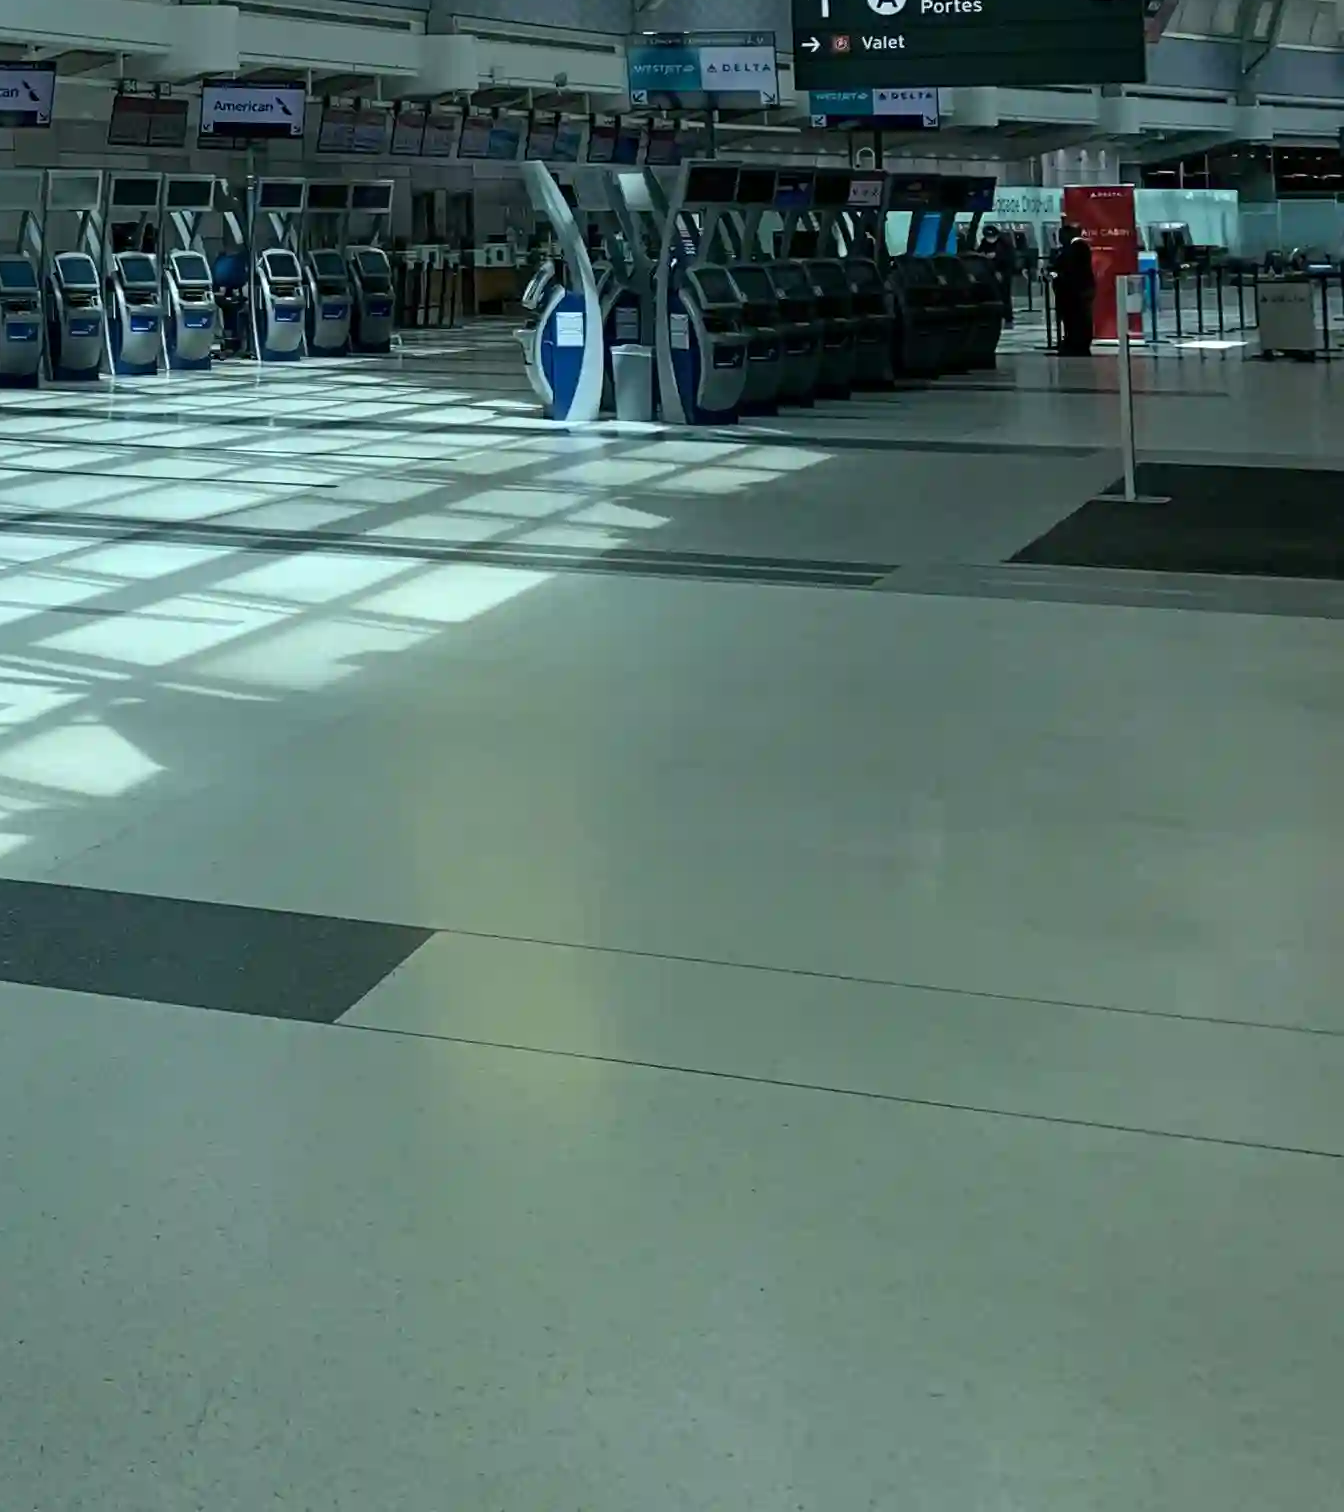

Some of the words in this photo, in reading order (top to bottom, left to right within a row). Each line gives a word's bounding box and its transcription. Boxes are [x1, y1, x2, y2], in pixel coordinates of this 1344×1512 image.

[920, 0, 983, 14] Portes
[861, 35, 905, 50] Valet
[722, 62, 772, 73] DELTA
[214, 100, 274, 114] American
